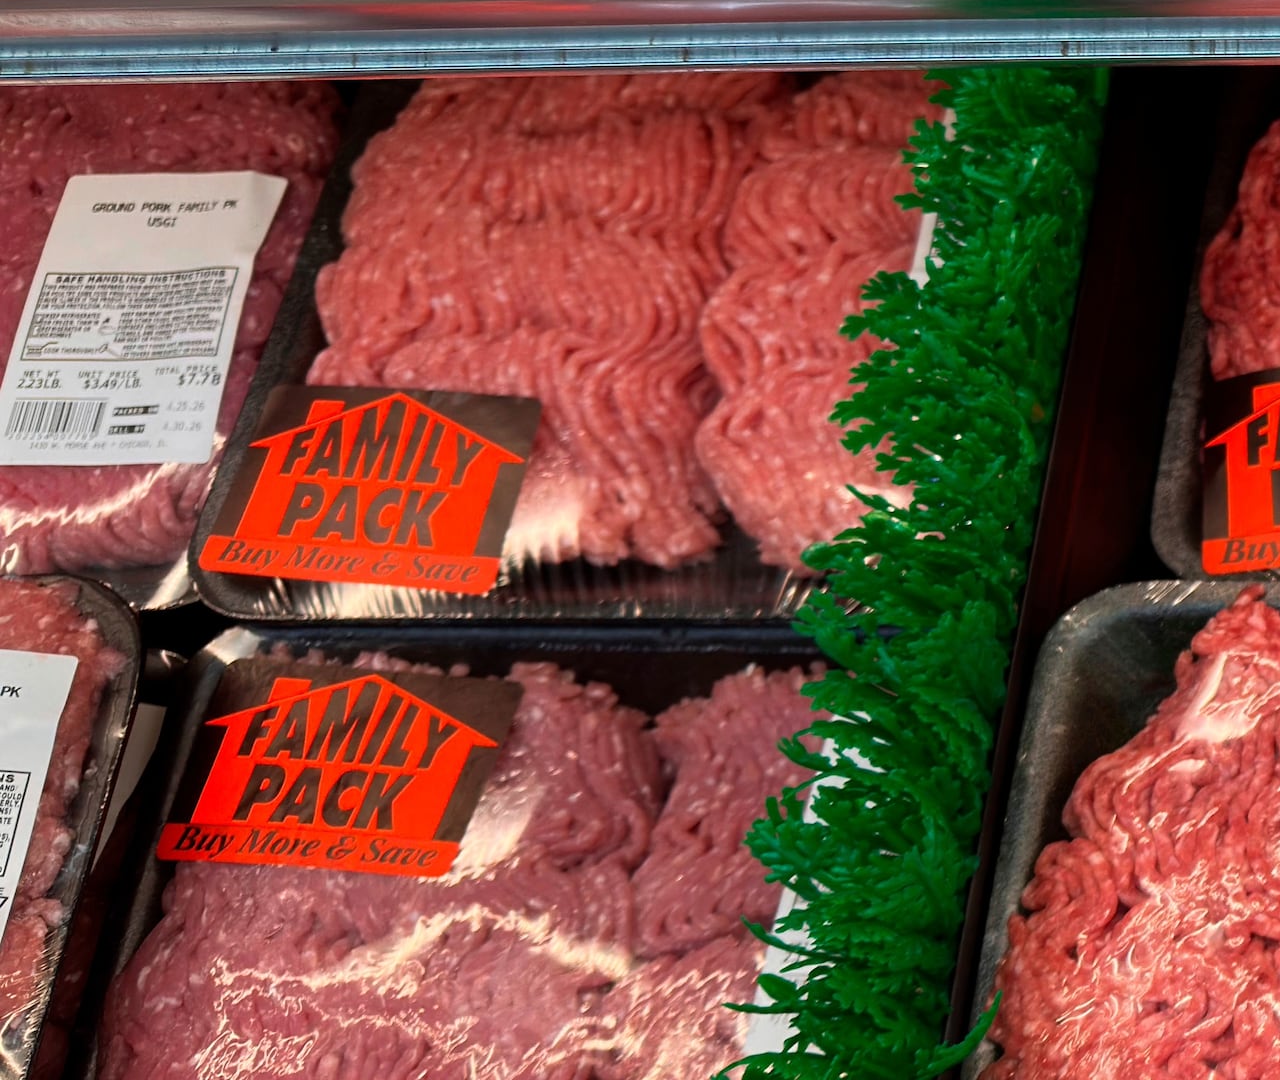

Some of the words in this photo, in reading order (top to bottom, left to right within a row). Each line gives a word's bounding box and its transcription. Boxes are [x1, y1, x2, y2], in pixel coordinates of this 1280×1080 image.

[92, 203, 135, 213] GROUND
[141, 202, 170, 213] PORK
[178, 201, 218, 212] FAMILY
[223, 200, 238, 209] PK
[177, 374, 221, 386] $7.78
[280, 399, 484, 487] FAMILY
[276, 486, 452, 548] PACK
[219, 539, 279, 570] Buy
[288, 546, 364, 576] More
[370, 553, 398, 574] &
[405, 556, 480, 584] Save
[240, 681, 458, 769] FAMILY
[233, 765, 416, 831] PACK
[173, 827, 234, 853] Buy
[236, 829, 319, 857] More
[328, 833, 357, 857] &
[360, 836, 439, 867] Save
